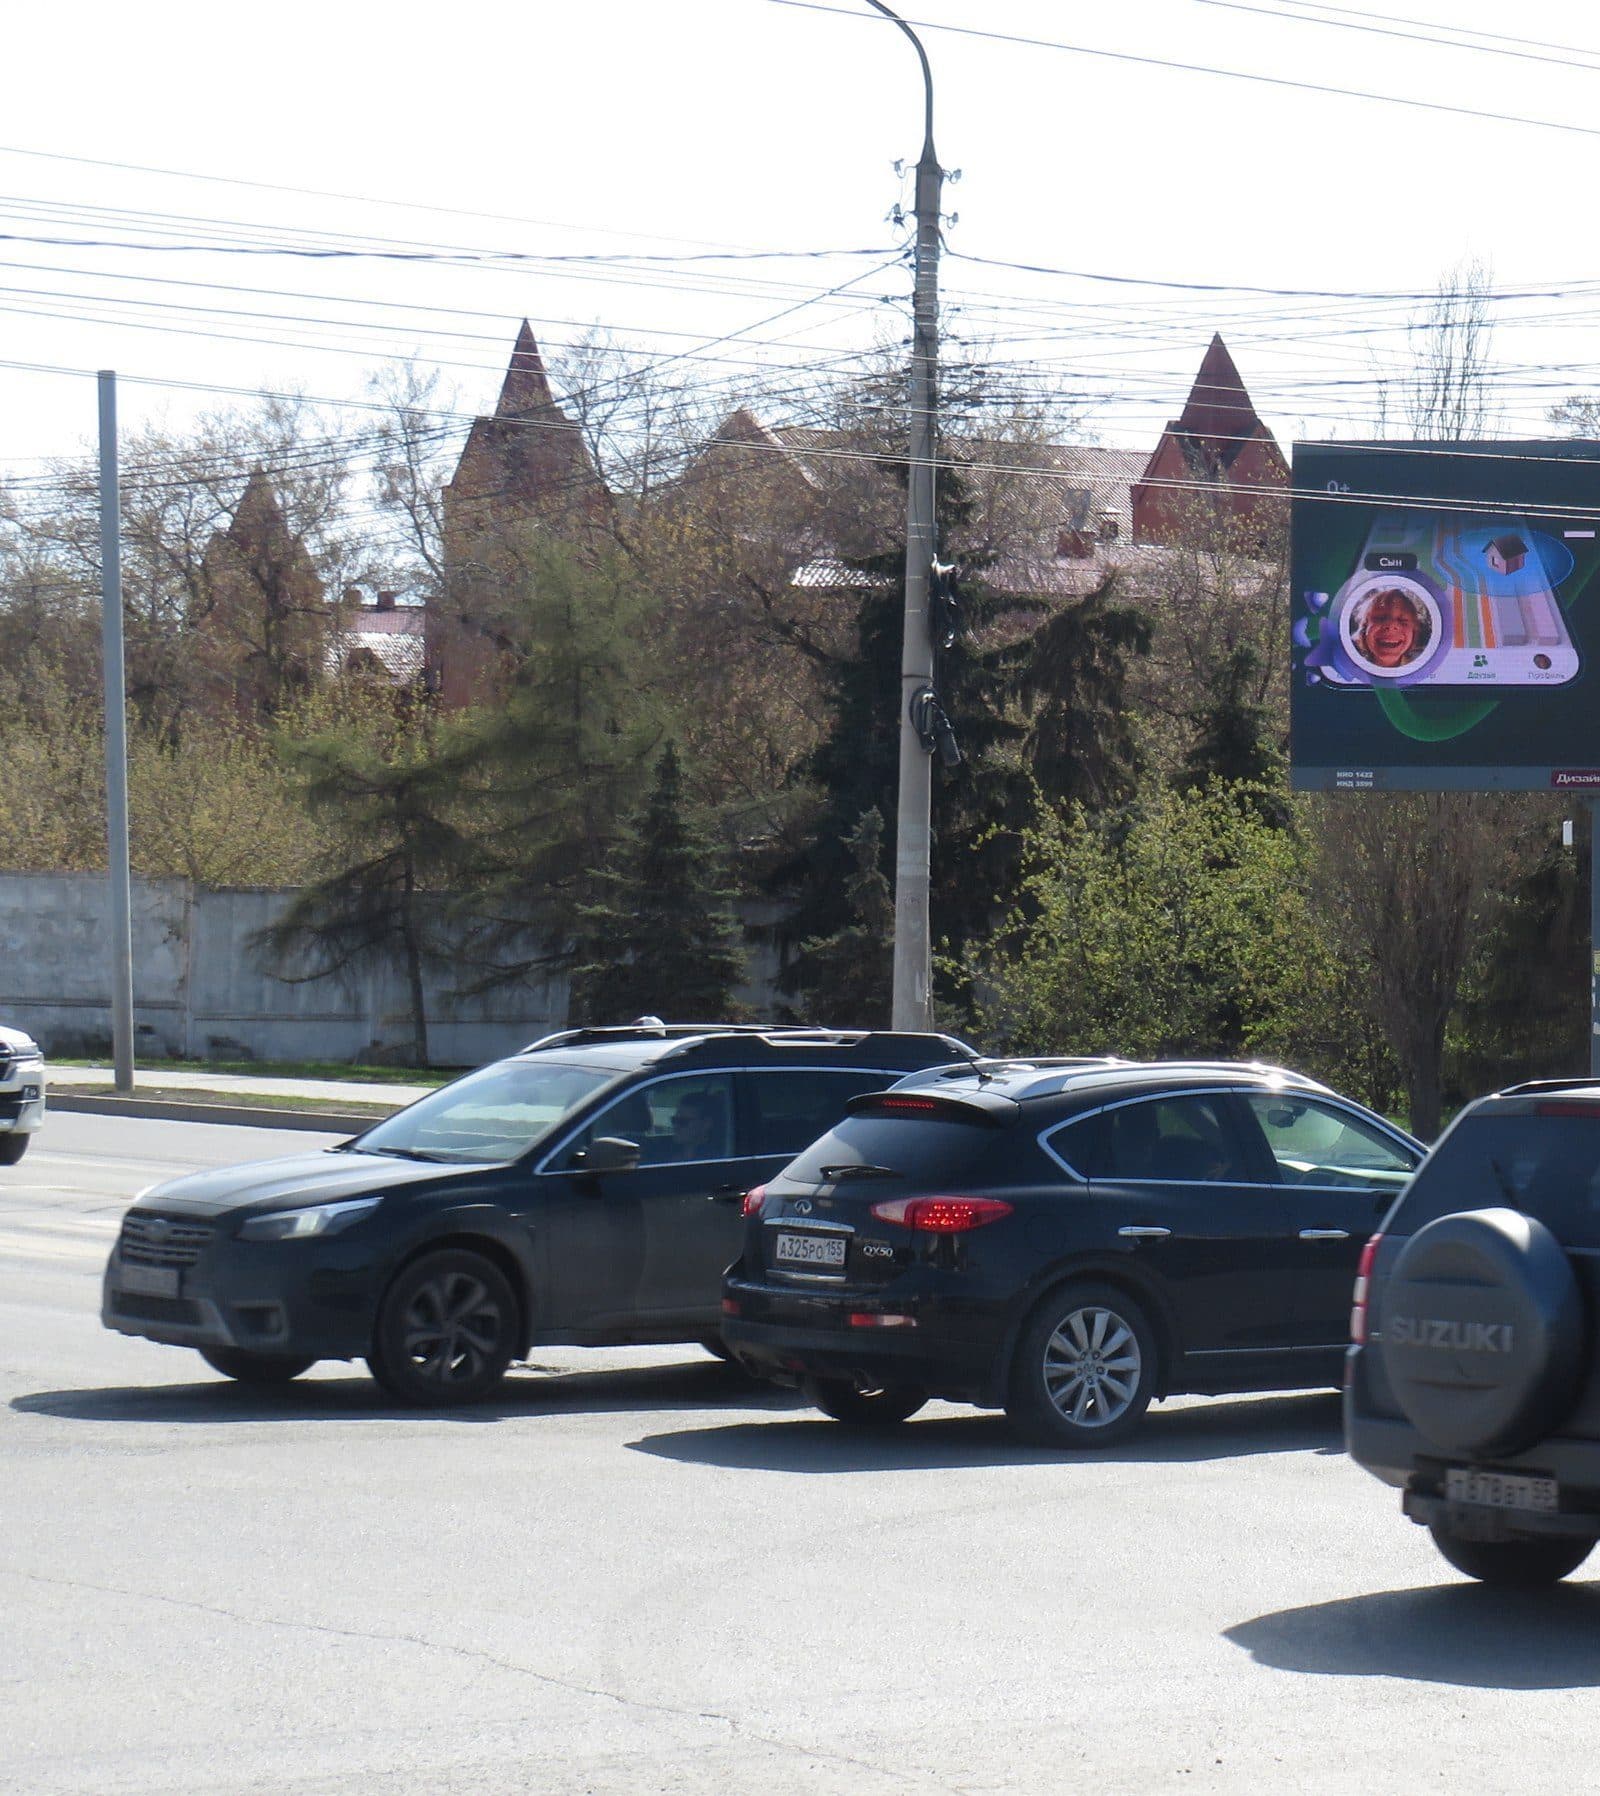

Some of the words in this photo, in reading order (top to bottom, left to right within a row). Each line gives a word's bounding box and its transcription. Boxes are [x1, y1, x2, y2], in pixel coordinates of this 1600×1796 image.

[1379, 557, 1403, 567] Сын
[826, 1241, 843, 1257] 155
[863, 1245, 893, 1257] QX50
[1390, 1318, 1513, 1353] SUZUKI
